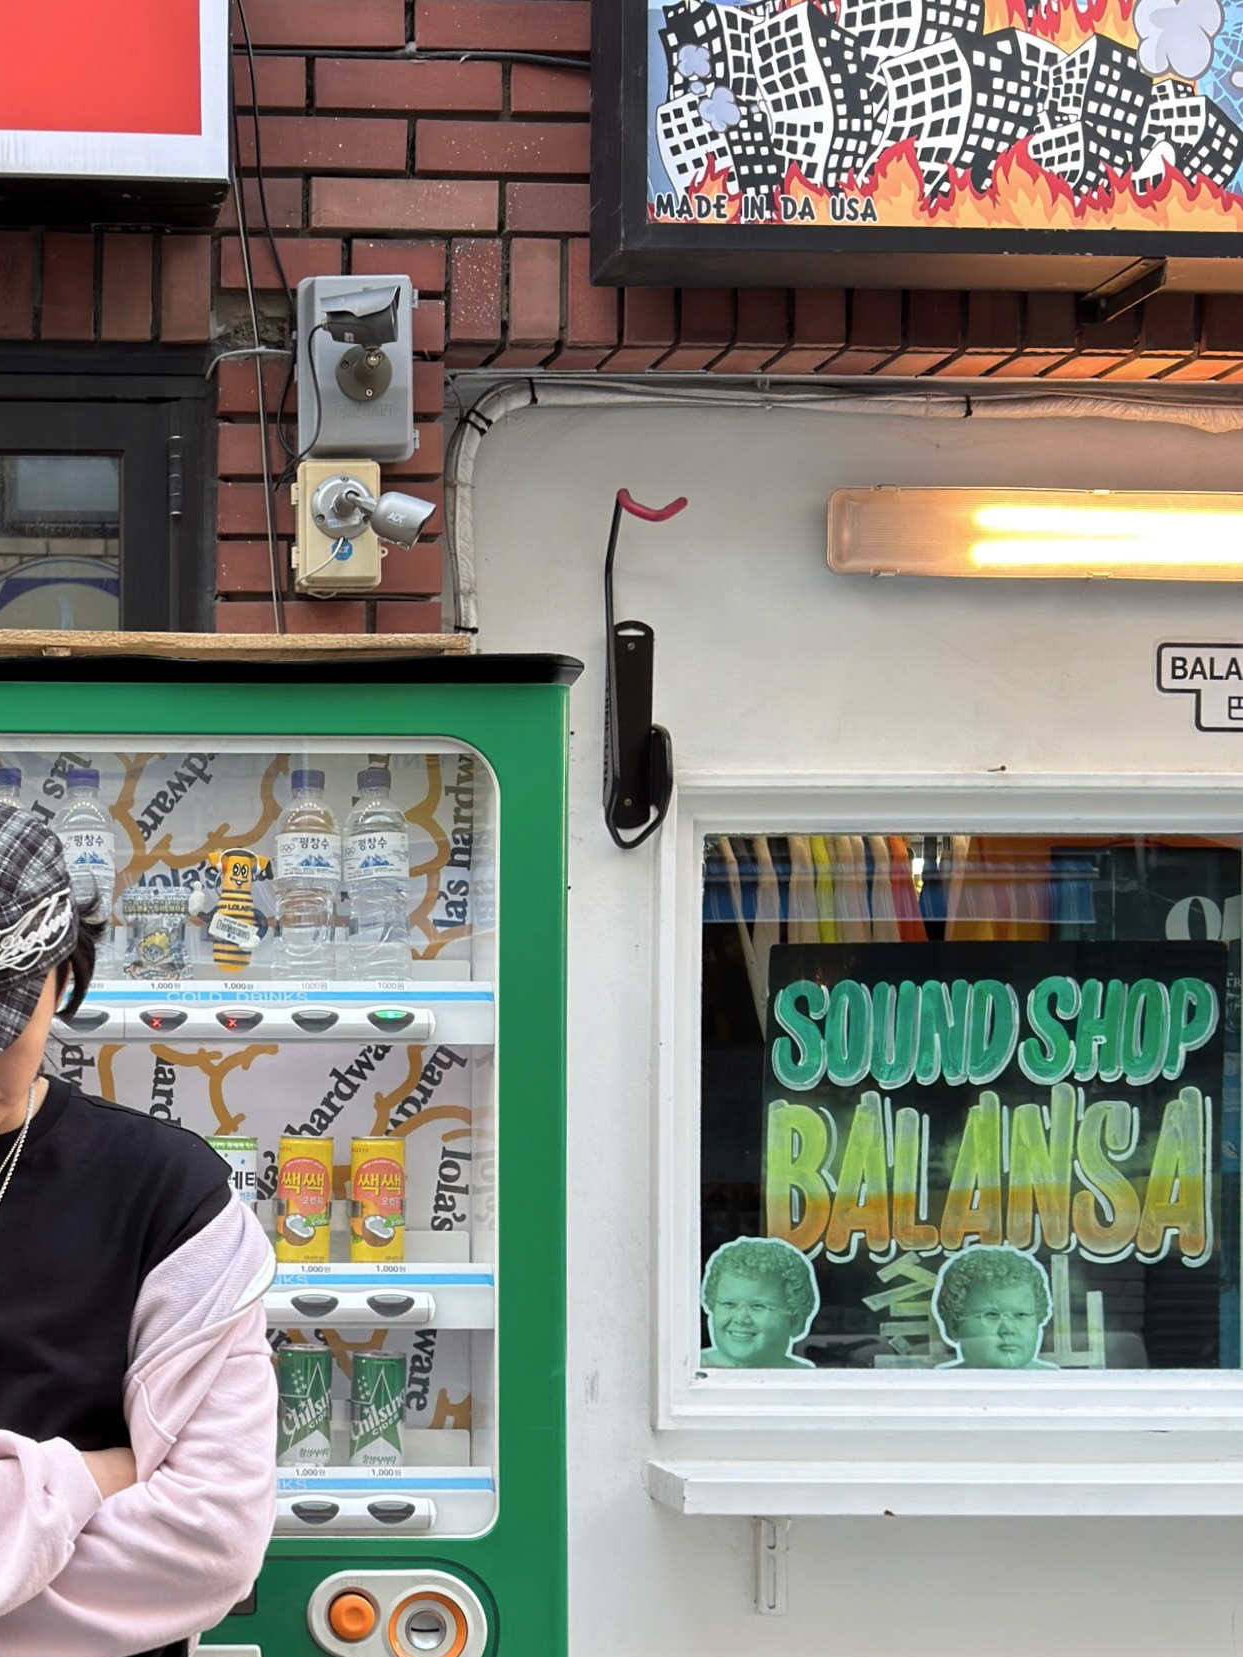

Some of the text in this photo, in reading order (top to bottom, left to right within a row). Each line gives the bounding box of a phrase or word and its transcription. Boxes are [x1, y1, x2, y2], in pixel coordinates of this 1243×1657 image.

[655, 192, 879, 223] MADE IN DA USA
[72, 834, 105, 847] 평창수
[299, 836, 331, 851] 평창수
[357, 836, 389, 852] 평창수
[300, 982, 328, 990] 1000원
[377, 982, 405, 990] 1000원
[166, 991, 309, 1001] COLD DRINKS
[772, 976, 1221, 1090] SOUND SHOP
[767, 1082, 1213, 1268] BALANSA
[300, 1265, 332, 1273] 1,000원
[375, 1265, 407, 1273] 1,000원
[372, 1413, 402, 1436] CIDER
[294, 1468, 327, 1477] 1,000원
[370, 1468, 403, 1477] 1,000원
